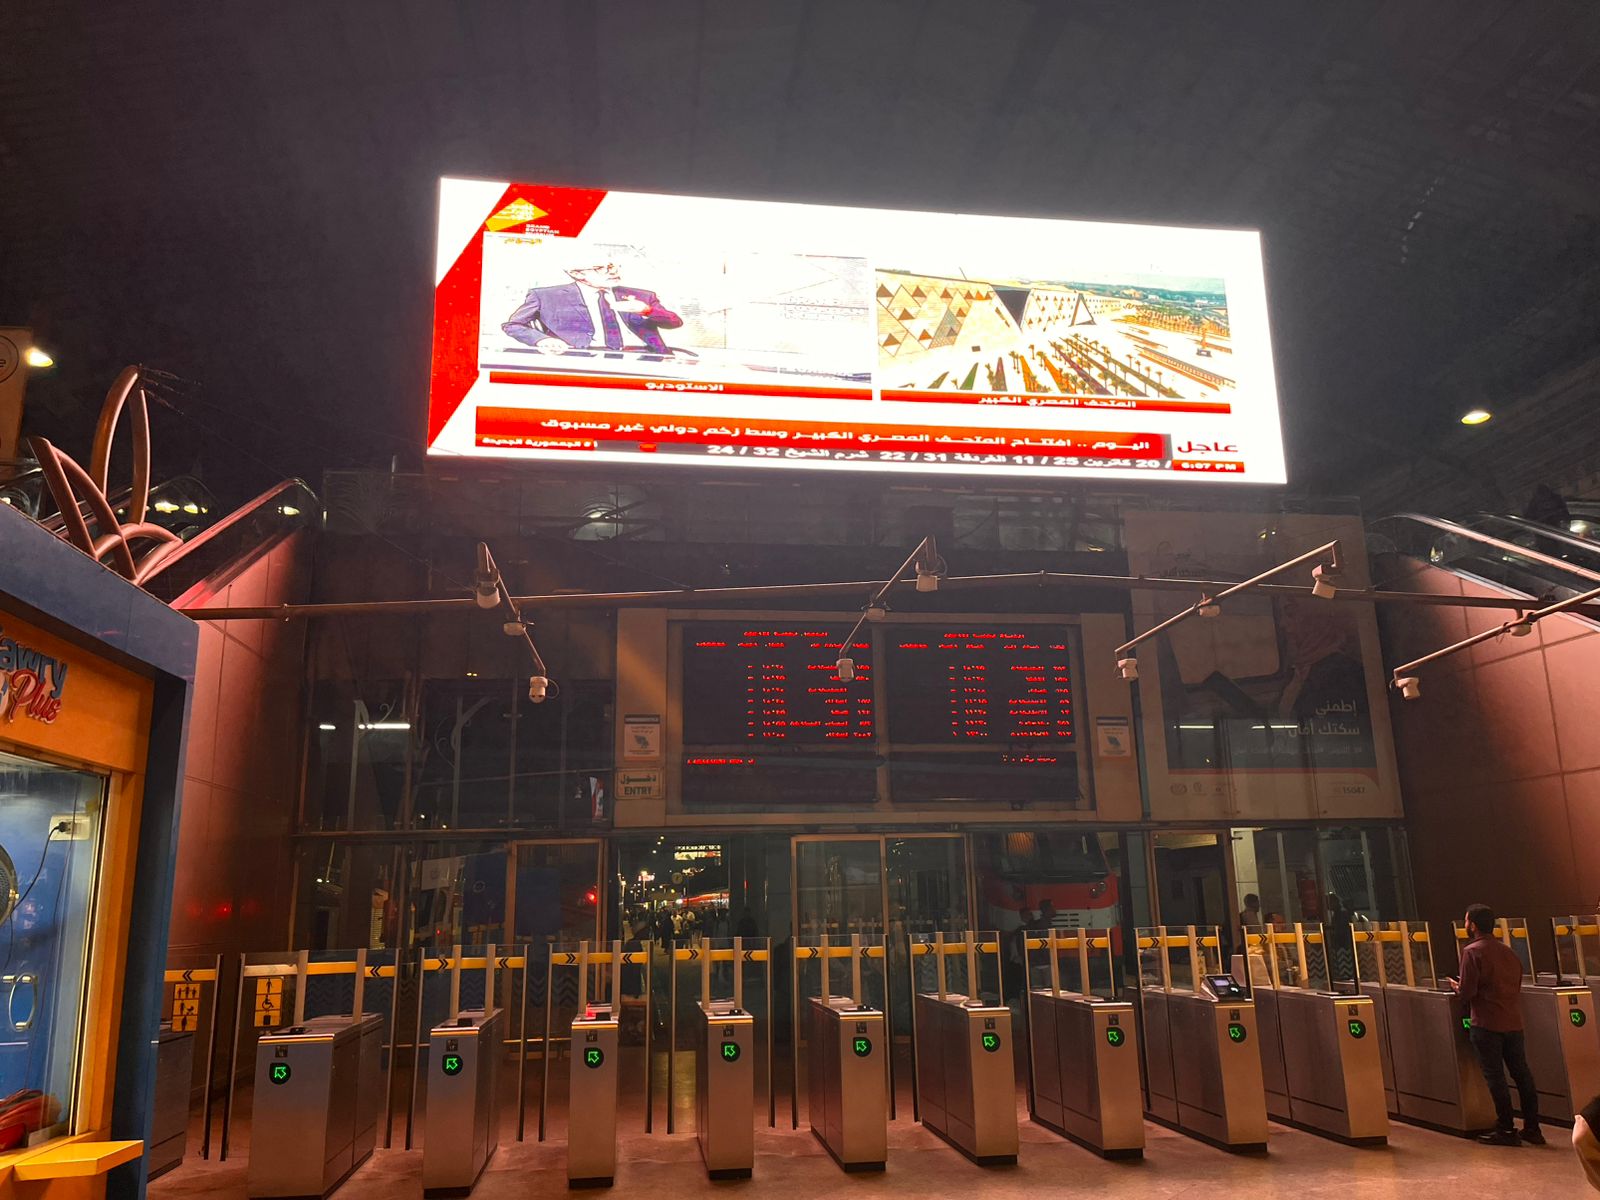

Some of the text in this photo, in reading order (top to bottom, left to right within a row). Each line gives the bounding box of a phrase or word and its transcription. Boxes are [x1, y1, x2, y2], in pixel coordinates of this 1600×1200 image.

[645, 382, 724, 391] الاستوديو
[1026, 398, 1079, 407] المصري
[1084, 399, 1137, 408] المتحف
[540, 418, 611, 430] مسبوق
[614, 422, 645, 432] غير
[649, 424, 699, 435] دولي
[703, 427, 740, 437] زخم
[744, 427, 789, 439] وسط
[706, 445, 735, 455] 24
[753, 447, 780, 457] 32
[1177, 440, 1239, 455] عاجل
[879, 451, 906, 461] 22
[923, 452, 948, 462] 31
[1053, 456, 1080, 466] 25
[8, 669, 61, 724] Plus
[1318, 721, 1361, 736] سكتك
[624, 786, 652, 795] ENTRY
